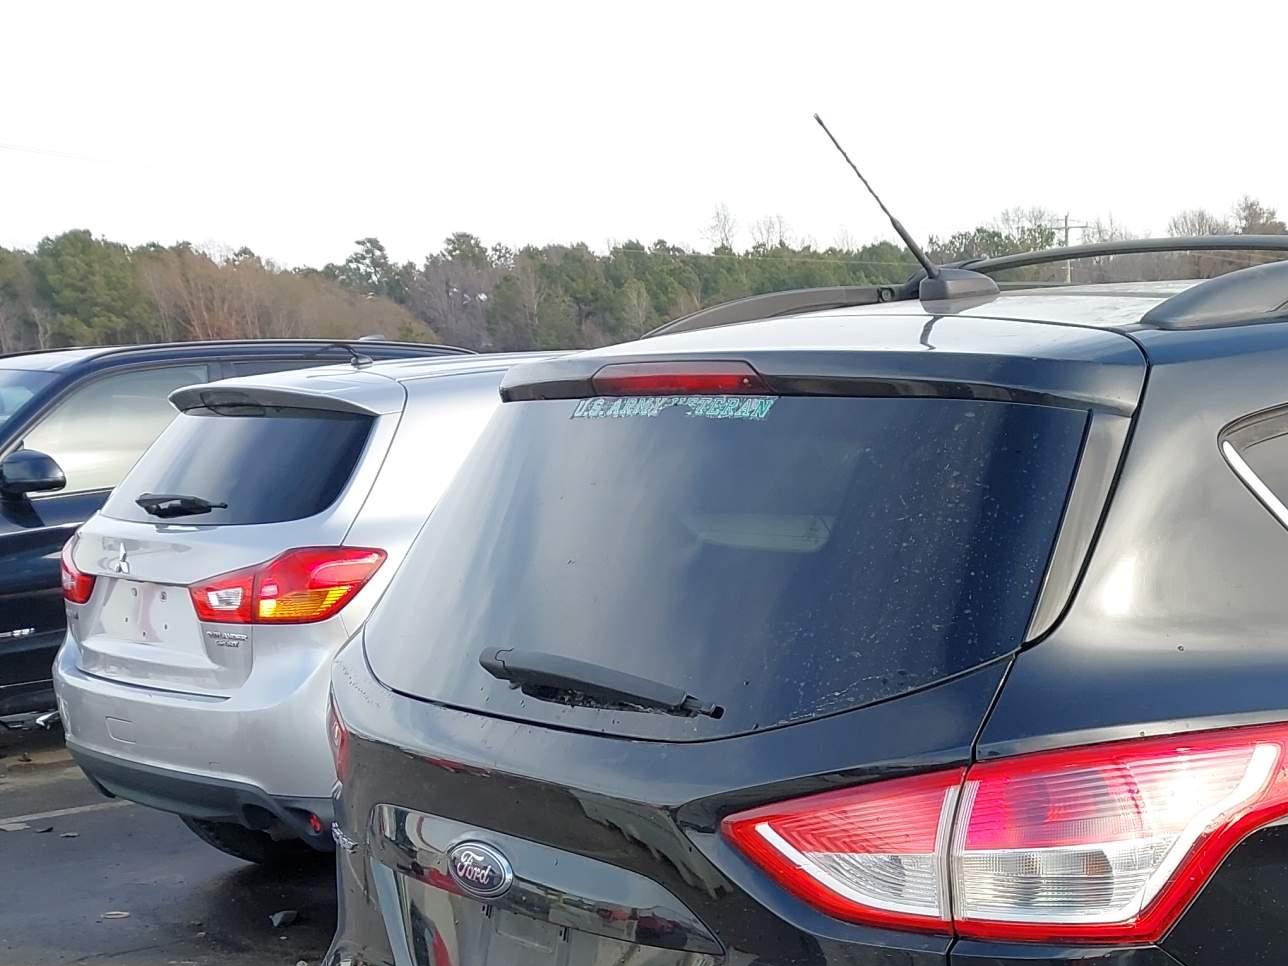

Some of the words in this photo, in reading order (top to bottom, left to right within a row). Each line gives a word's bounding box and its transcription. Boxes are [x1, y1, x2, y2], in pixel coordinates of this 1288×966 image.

[573, 398, 605, 417] U.S.
[606, 396, 667, 418] ARMY
[456, 850, 493, 885] Ford
